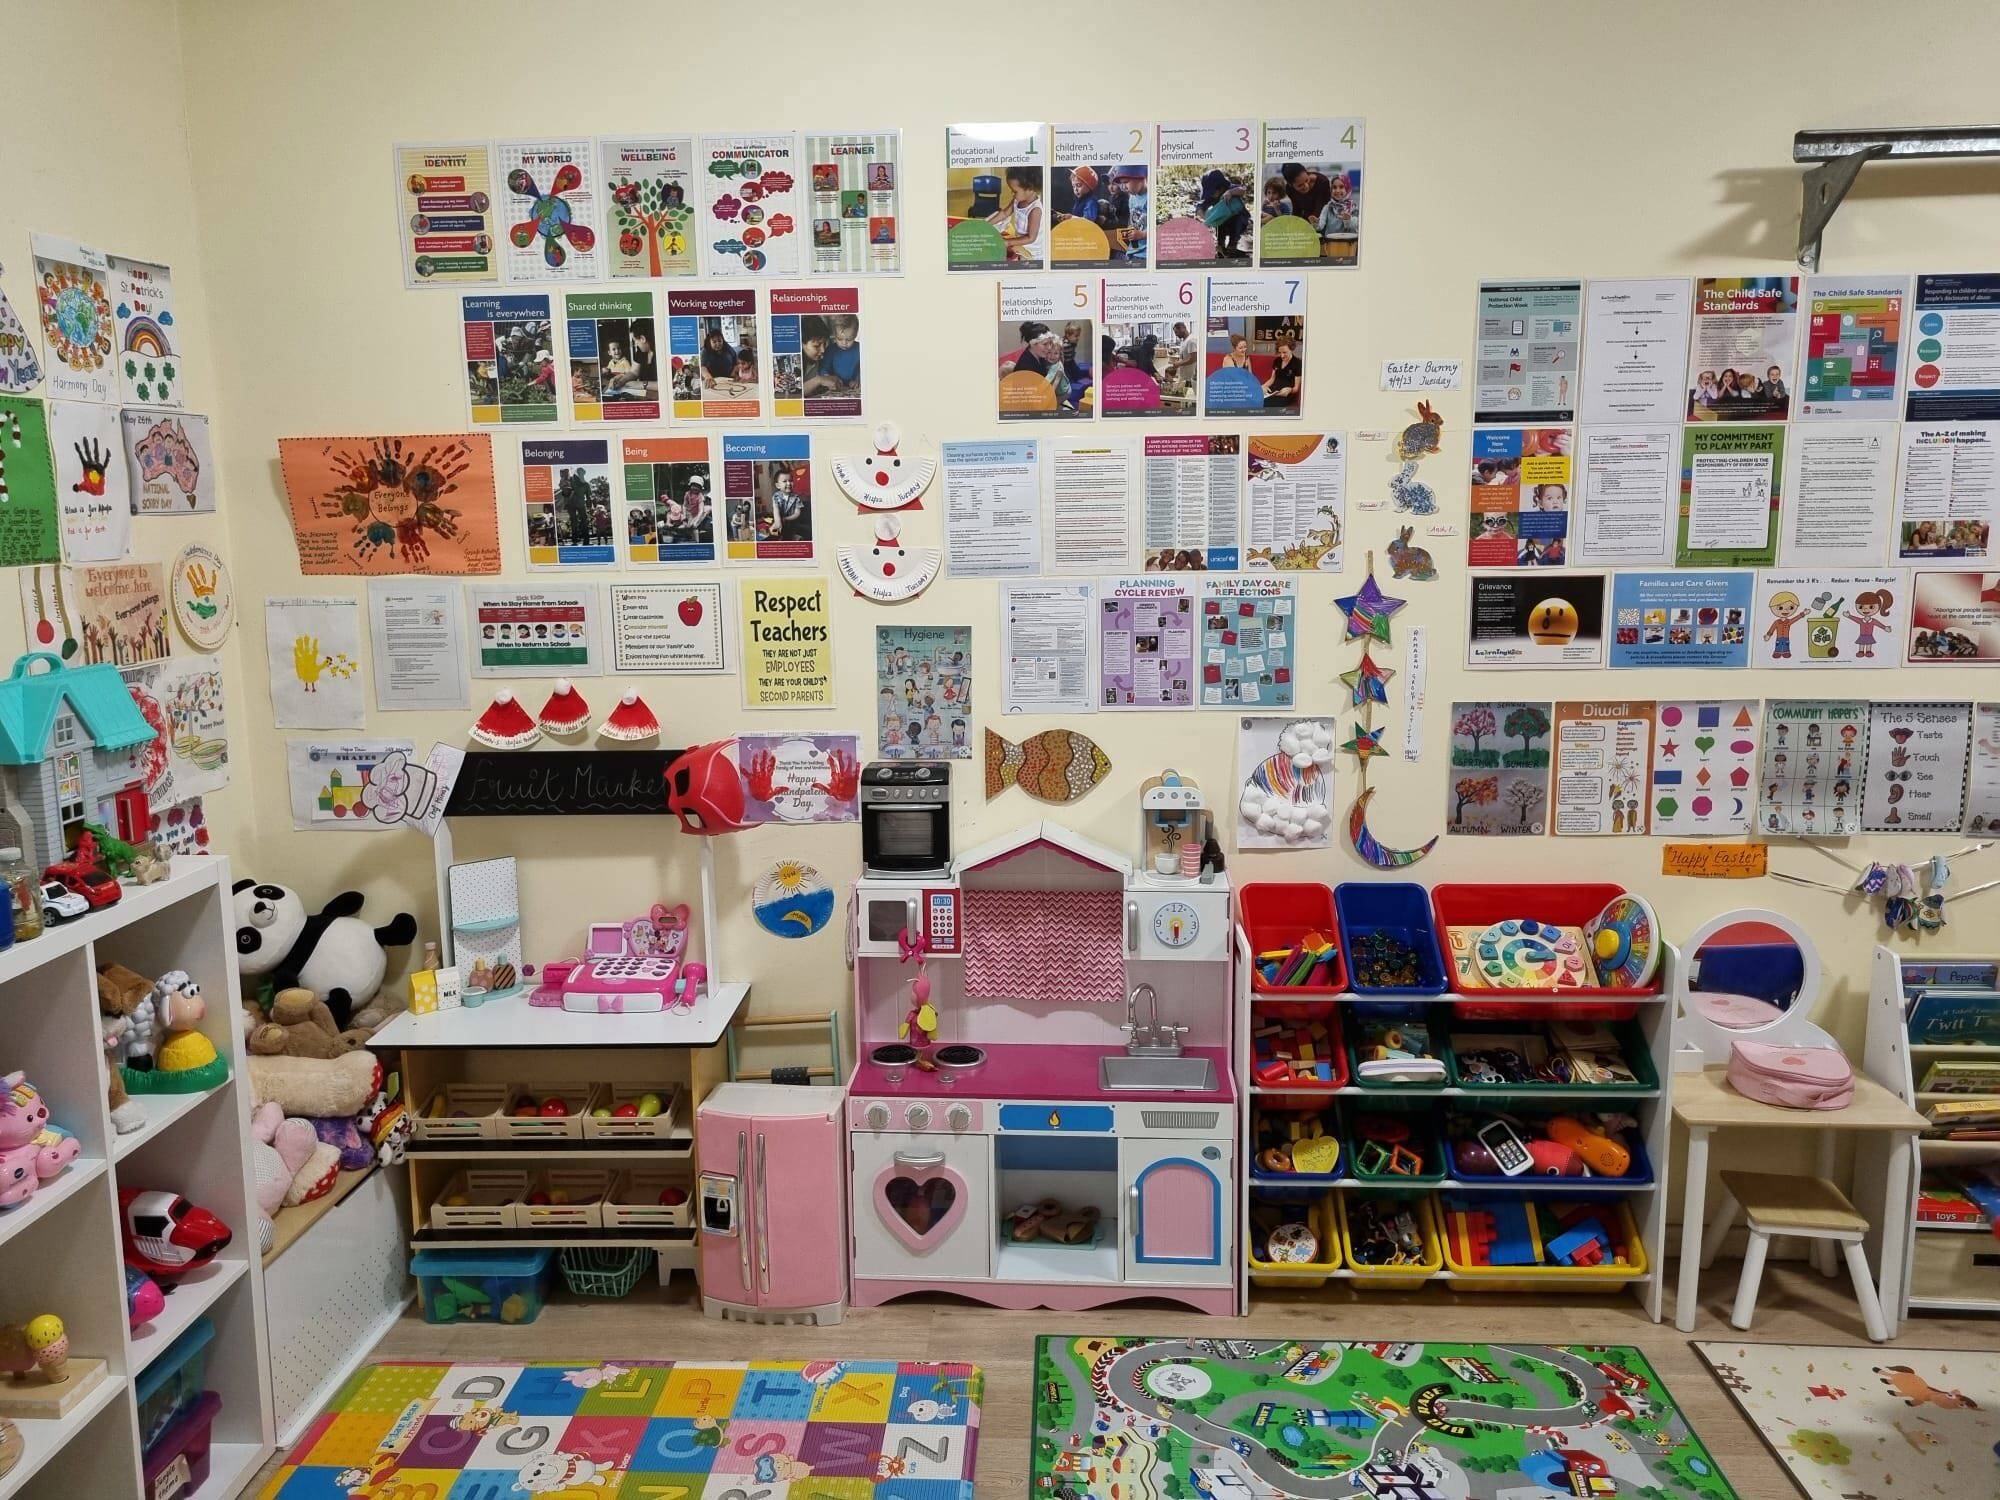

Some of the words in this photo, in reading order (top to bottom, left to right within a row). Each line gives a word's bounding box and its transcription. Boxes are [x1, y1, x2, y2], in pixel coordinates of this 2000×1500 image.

[1129, 129, 1143, 153] 2
[1235, 127, 1250, 151] 3
[1340, 125, 1357, 149] 4
[1056, 142, 1094, 152] children's
[1161, 141, 1194, 152] physical
[1267, 139, 1297, 149] staffing
[712, 150, 789, 159] COMMUNICATOR
[831, 147, 874, 156] LEARNER
[951, 146, 994, 155] educational
[1161, 151, 1212, 160] environment
[1267, 150, 1324, 158] arrangements
[522, 156, 535, 164] MY
[538, 155, 572, 163] WORLD
[621, 153, 676, 161] WELLBEING
[951, 156, 982, 165] program
[985, 155, 998, 163] and
[1001, 155, 1030, 164] practice
[1056, 152, 1080, 161] health
[1082, 152, 1097, 161] and
[1100, 152, 1123, 162] safety
[425, 158, 467, 167] IDENTITY
[128, 266, 153, 283] Happy
[131, 283, 163, 299] Patrick's
[1073, 285, 1088, 307] 5
[1179, 282, 1193, 305] 6
[1285, 281, 1299, 304] 7
[1704, 289, 1724, 299] The
[1727, 289, 1754, 298] Child
[1758, 288, 1782, 298] Safe
[1867, 288, 1902, 296] Standards
[772, 294, 827, 303] Relationships
[1002, 298, 1052, 307] relationships
[1212, 295, 1257, 303] governance
[465, 300, 500, 310] Learning
[569, 302, 596, 311] Shared
[599, 301, 632, 312] thinking
[671, 299, 707, 309] Working
[709, 299, 745, 309] together
[822, 303, 850, 311] matter
[1106, 304, 1148, 312] partnerships
[1229, 302, 1270, 312] leadership
[1703, 301, 1759, 311] Standards
[496, 310, 544, 319] everywhere
[1002, 308, 1019, 316] with
[1021, 307, 1052, 315] children
[1107, 312, 1131, 320] families
[1148, 311, 1190, 319] communities
[1388, 363, 1420, 373] Easter
[1425, 363, 1458, 375] Bunny
[53, 376, 88, 397] Harmony
[92, 379, 106, 401] Day
[525, 448, 564, 459] Belonging
[625, 447, 648, 457] Being
[725, 443, 766, 454] Becoming
[374, 491, 410, 501] Everyone
[378, 503, 409, 513] Belongs
[87, 567, 135, 585] Everyone
[86, 583, 127, 597] welcome
[134, 580, 152, 593] here
[1119, 580, 1175, 588] PLANNING
[1206, 580, 1241, 589] FAMILY
[1242, 579, 1262, 587] DAY
[1263, 580, 1291, 588] CARE
[1479, 582, 1512, 590] Grievance
[1115, 589, 1147, 597] CYCLE
[1148, 588, 1184, 596] REVIEW
[754, 590, 821, 618] Respect
[115, 602, 141, 621] Everyone
[751, 620, 827, 642] Teachers
[904, 629, 945, 641] Hygiene
[762, 649, 777, 658] THEY
[778, 649, 789, 657] ARE
[789, 649, 801, 657] NOT
[803, 649, 817, 658] JUST
[766, 661, 815, 673] EMPLOYEES
[759, 678, 772, 687] THEY
[774, 678, 785, 687] ARE
[786, 678, 801, 686] YOUR
[803, 677, 824, 686] CHILD'S
[760, 691, 789, 702] SECOND
[792, 690, 823, 701] PARENTS
[1583, 704, 1629, 717] Diwali
[1773, 707, 1822, 719] COMMUNITY
[1880, 712, 1903, 723] The
[1905, 713, 1914, 723] 5
[1917, 713, 1958, 723] Senses
[1917, 730, 1943, 739] Taste
[1913, 753, 1940, 762] Touch
[1504, 760, 1540, 768] SUMMER
[468, 760, 566, 803] Fruit
[572, 762, 670, 796] Marke
[787, 773, 816, 786] Happy
[1917, 772, 1933, 781] See
[1909, 790, 1932, 798] Hear
[1907, 812, 1932, 821] Smell
[1450, 825, 1488, 834] AUTUMN
[1501, 825, 1532, 834] WINTER
[1670, 850, 1709, 868] Happy
[1715, 850, 1761, 864] Easter
[933, 896, 951, 905] 10:30
[1170, 903, 1184, 914] 12
[1950, 971, 1981, 984] Peppa
[443, 990, 456, 998] MILK
[1936, 1211, 1957, 1222] toys
[452, 1375, 505, 1400] D
[752, 1379, 801, 1405] T
[832, 1382, 884, 1406] X
[496, 1425, 549, 1455] G
[734, 1432, 786, 1457] S
